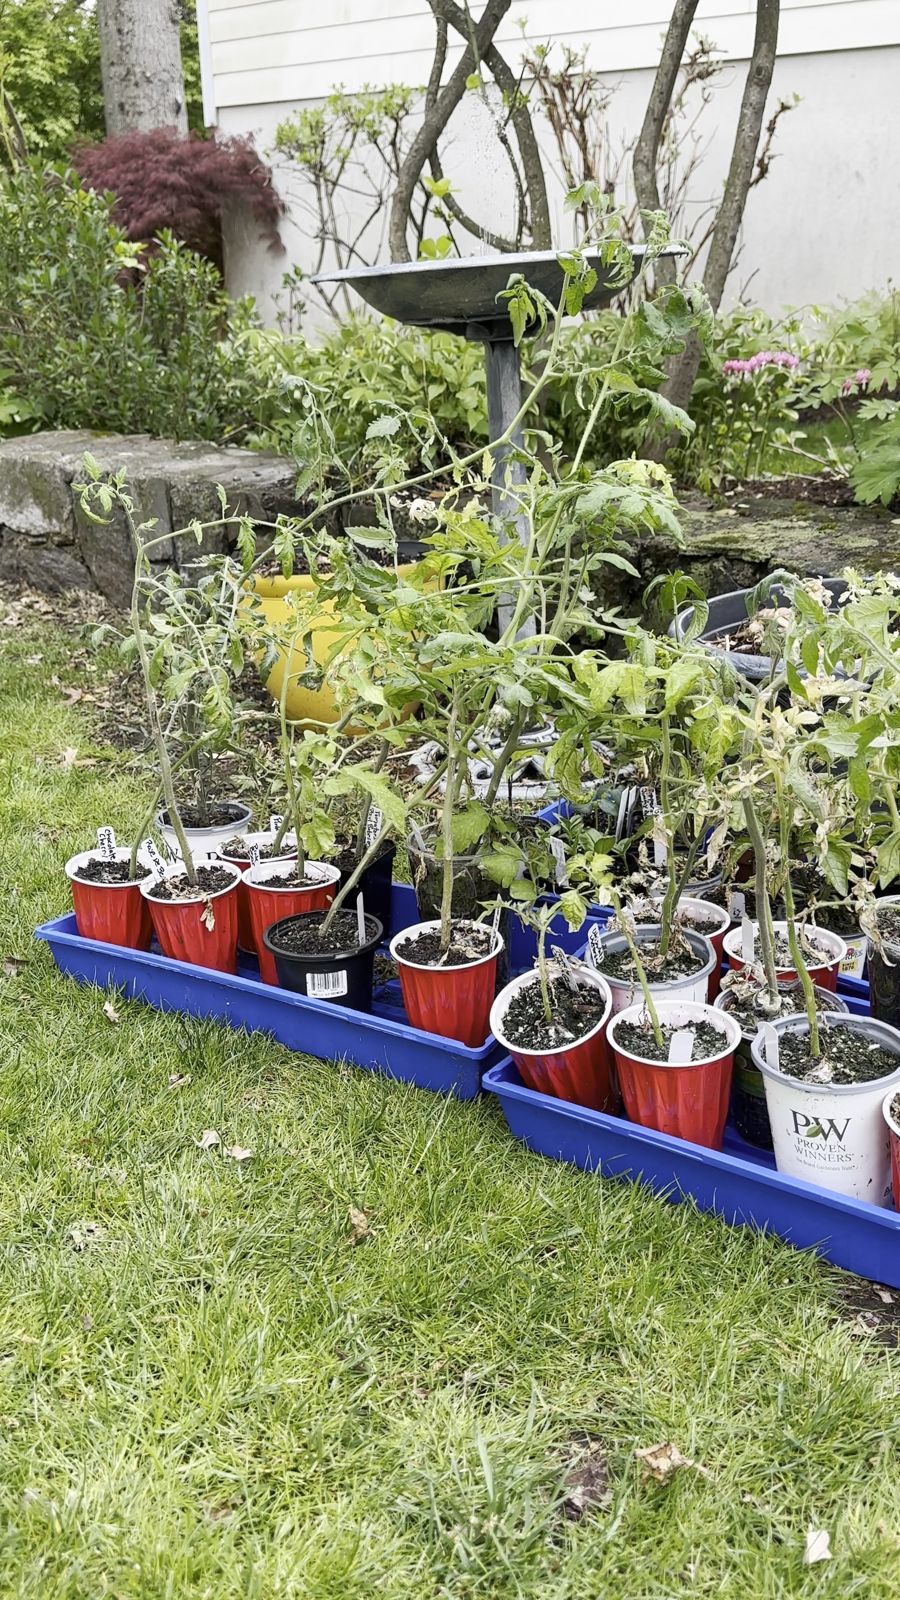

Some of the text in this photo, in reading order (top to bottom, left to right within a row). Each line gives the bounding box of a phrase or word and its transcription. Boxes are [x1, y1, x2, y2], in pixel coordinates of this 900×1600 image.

[98, 833, 109, 858] Cherry
[104, 828, 117, 861] Chocolate
[797, 1137, 847, 1153] PROVEN
